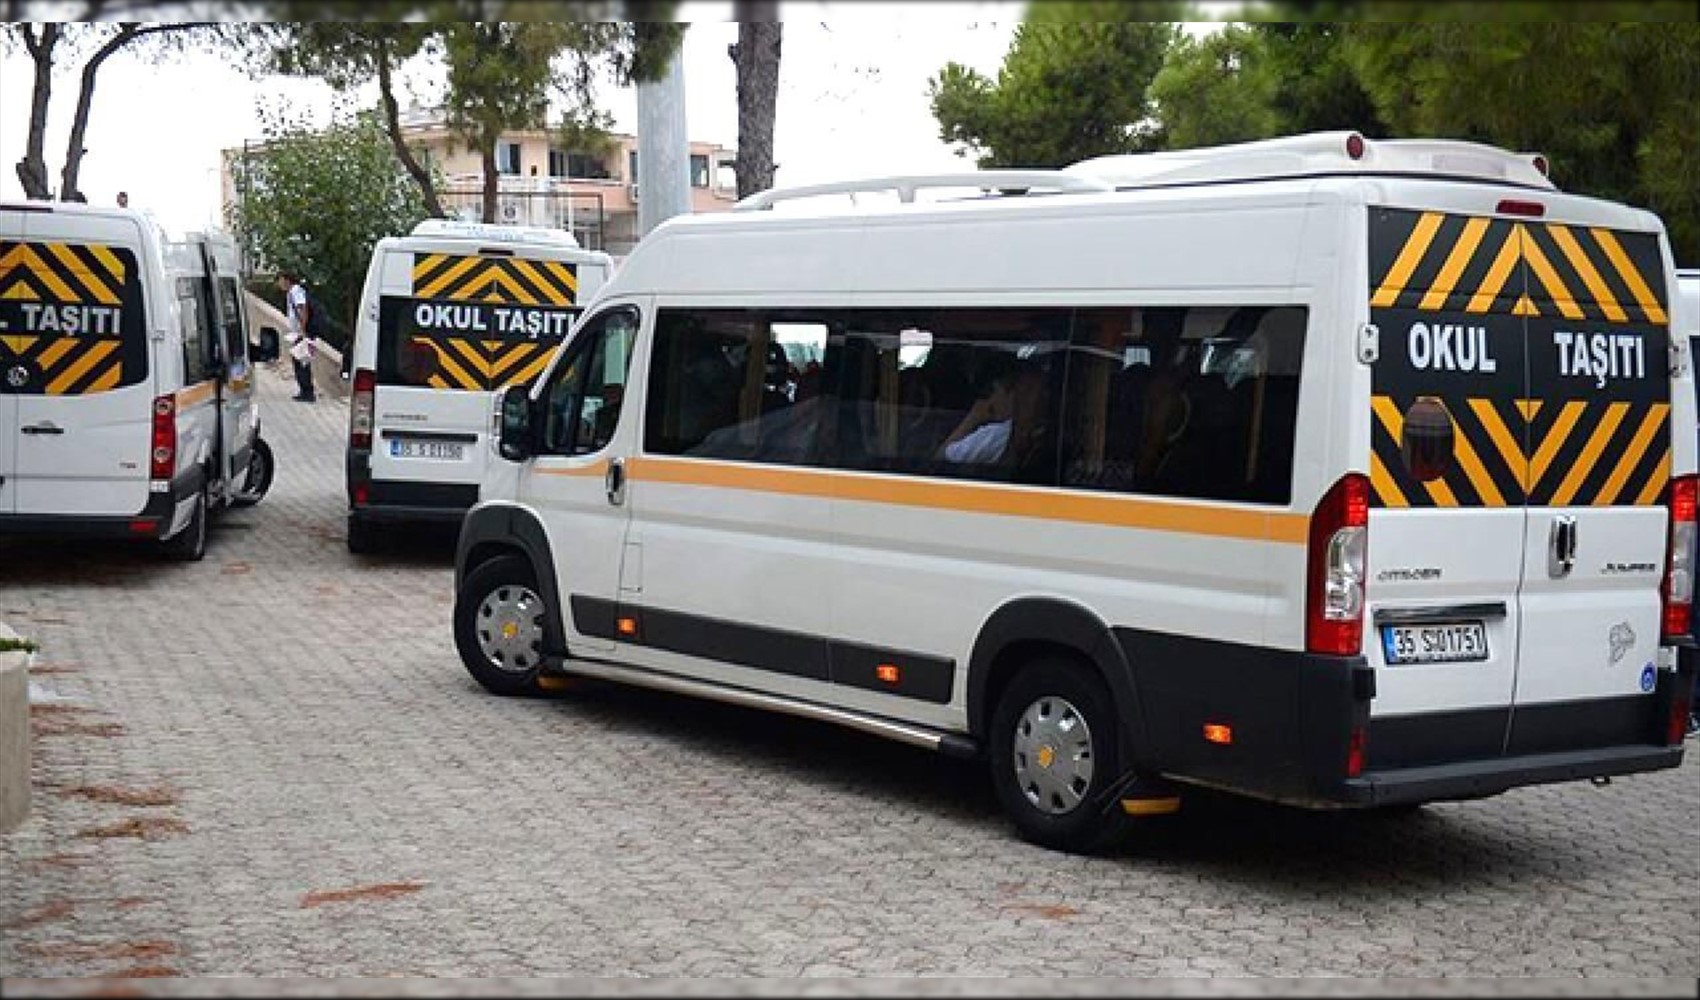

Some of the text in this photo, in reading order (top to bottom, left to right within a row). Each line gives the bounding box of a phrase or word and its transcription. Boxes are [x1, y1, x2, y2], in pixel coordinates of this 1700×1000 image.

[21, 303, 120, 336] TAŞITI
[416, 303, 487, 331] OKUL
[1408, 321, 1646, 389] OKUL TAŞITI
[1395, 628, 1416, 654] 35
